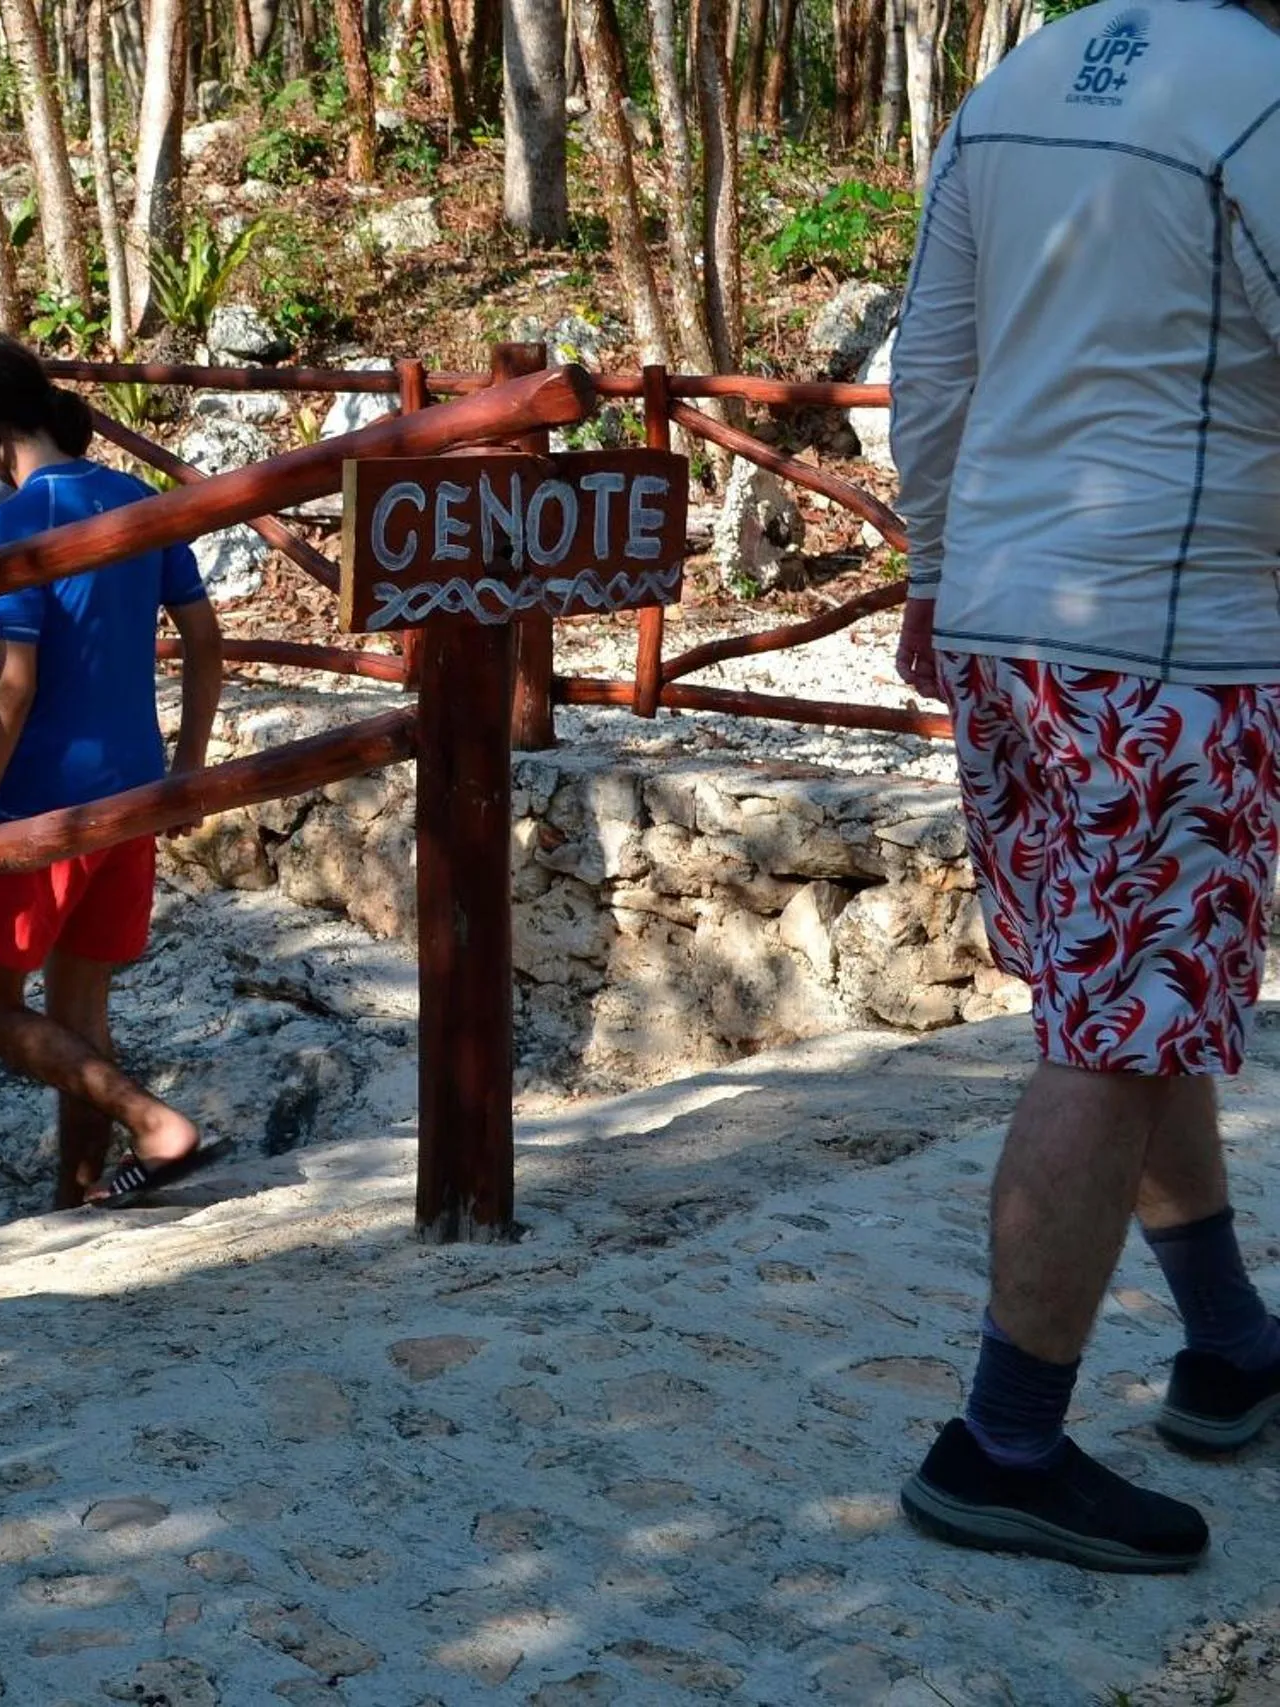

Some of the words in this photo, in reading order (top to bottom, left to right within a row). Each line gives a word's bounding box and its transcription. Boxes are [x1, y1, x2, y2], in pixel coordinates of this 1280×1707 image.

[1083, 38, 1150, 66] UPF
[1073, 66, 1128, 93] 50+
[371, 470, 669, 572] CENOTE
